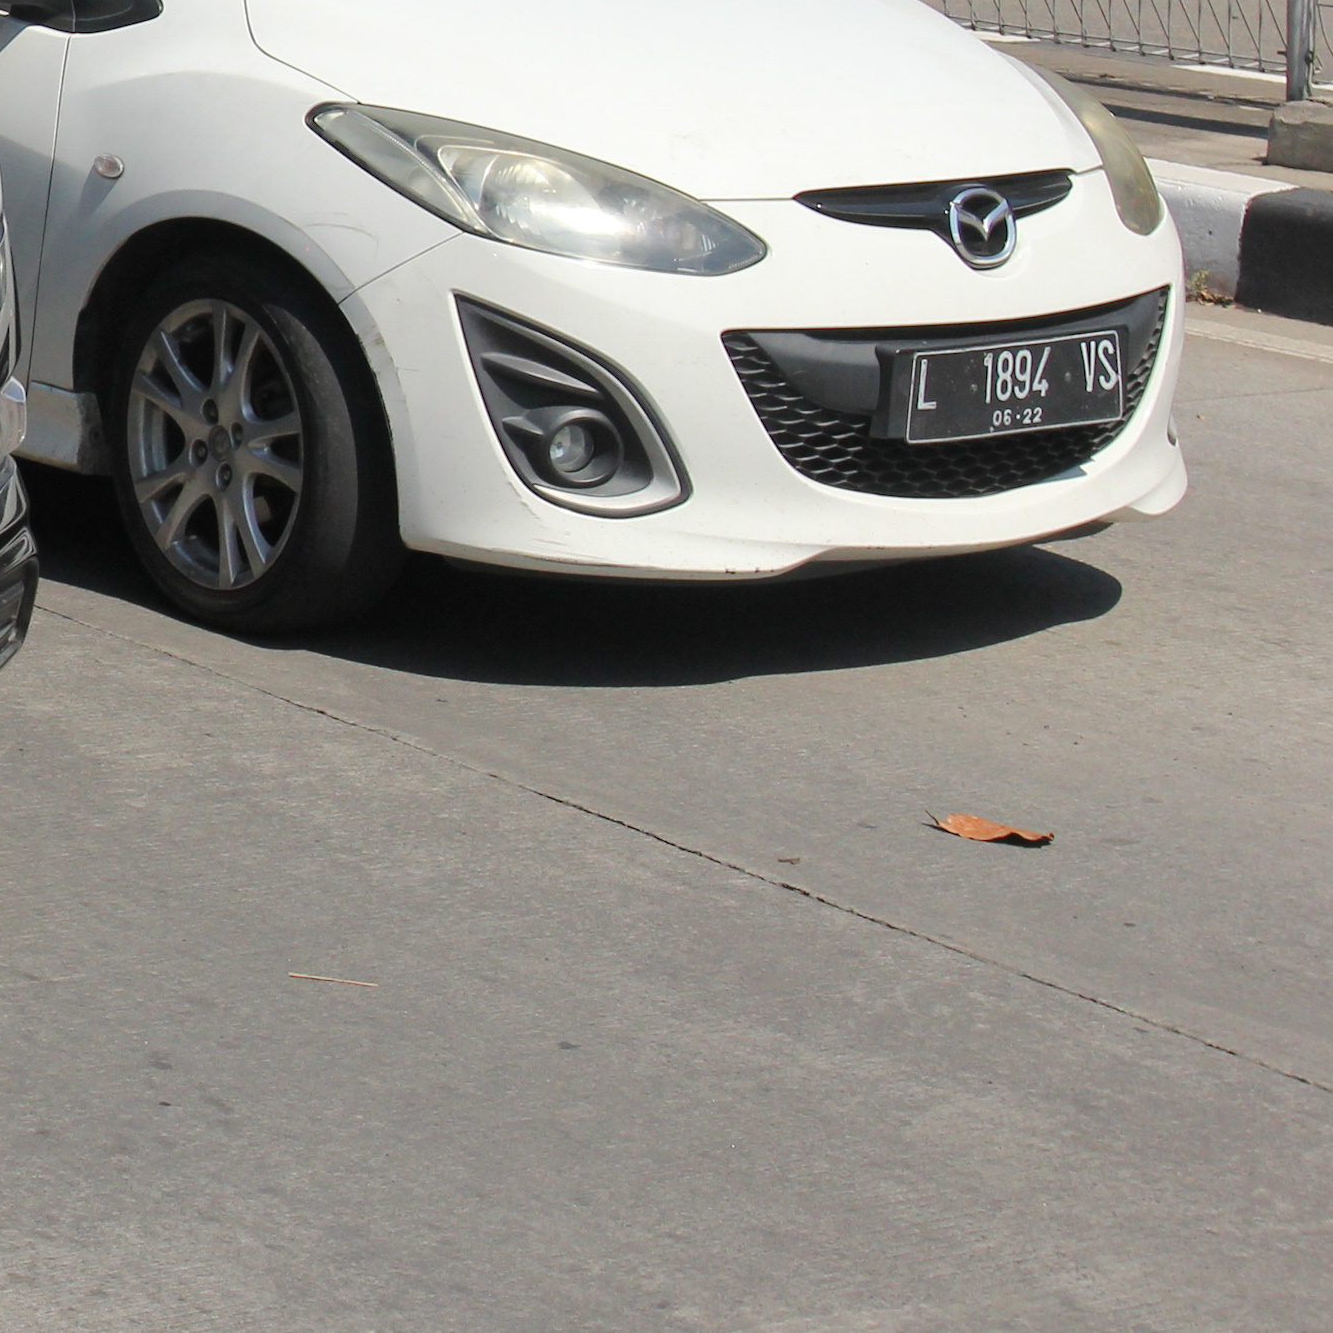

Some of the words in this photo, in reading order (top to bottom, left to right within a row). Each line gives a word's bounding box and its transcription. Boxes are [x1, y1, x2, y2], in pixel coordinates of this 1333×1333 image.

[917, 358, 937, 410] L
[983, 346, 1052, 404] 1894
[1080, 339, 1118, 393] VS
